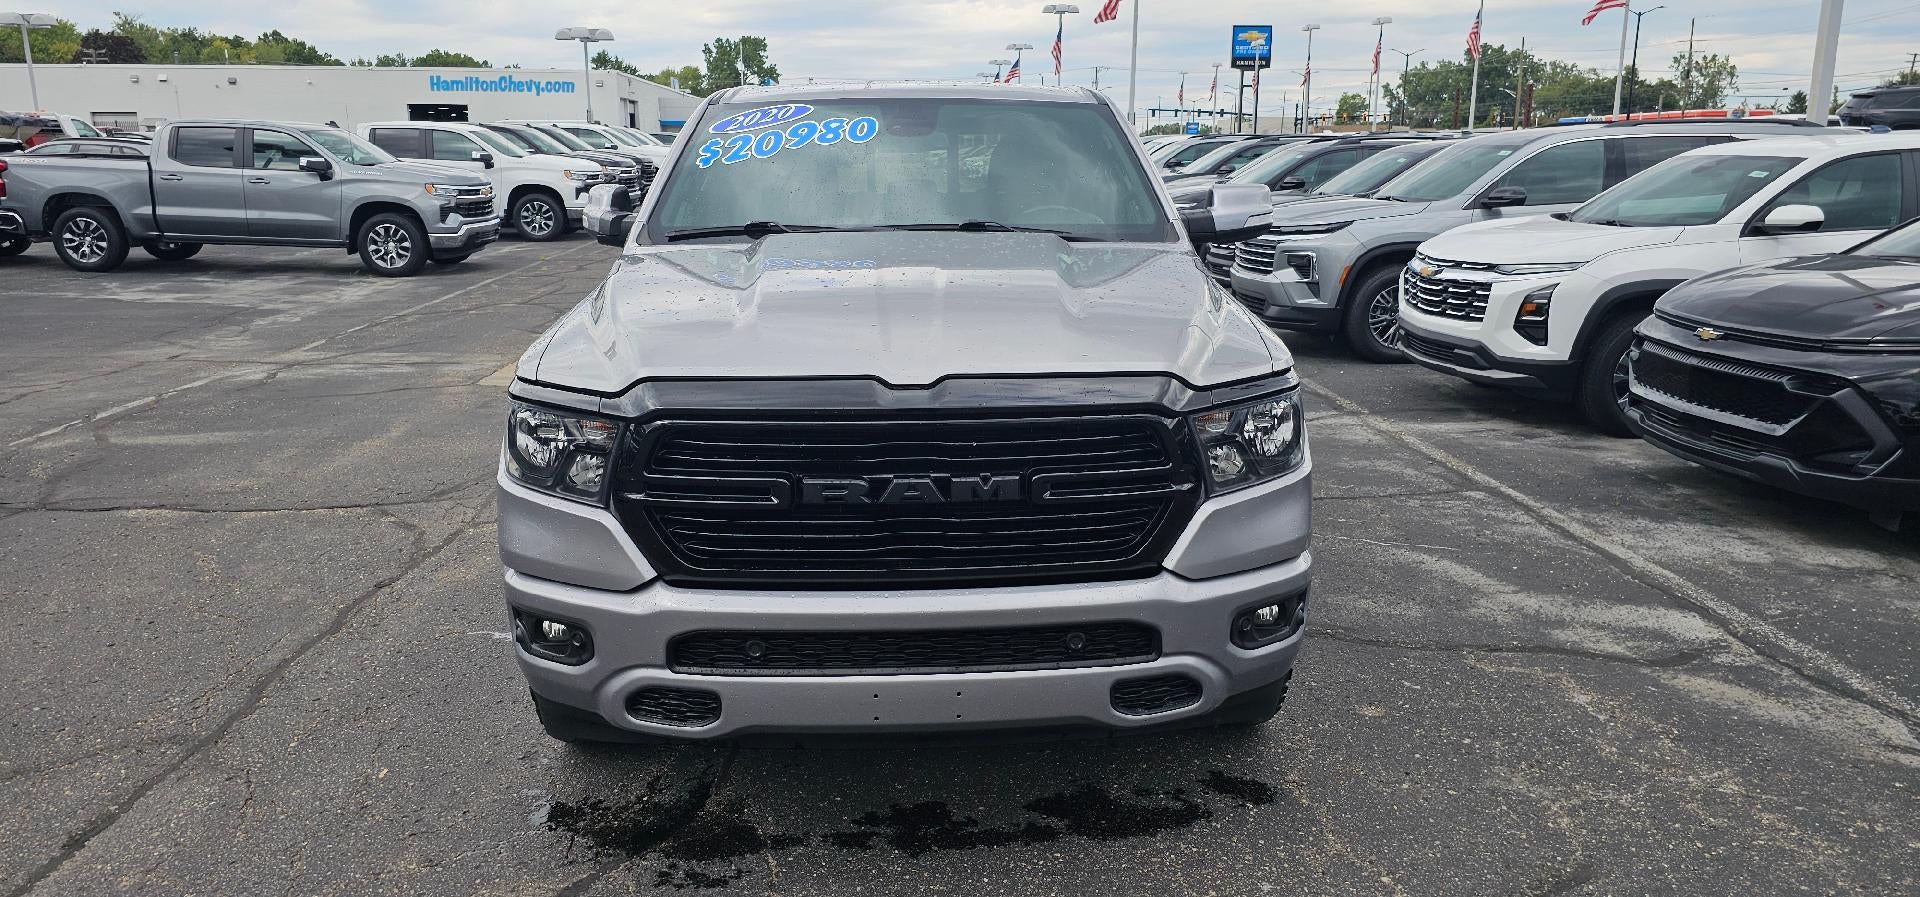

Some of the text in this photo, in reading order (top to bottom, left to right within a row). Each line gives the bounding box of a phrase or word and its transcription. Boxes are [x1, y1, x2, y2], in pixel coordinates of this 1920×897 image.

[429, 75, 576, 96] HamiltonChevy.com
[723, 104, 796, 132] 2020
[696, 117, 879, 168] $20980
[801, 473, 1021, 504] RAM
